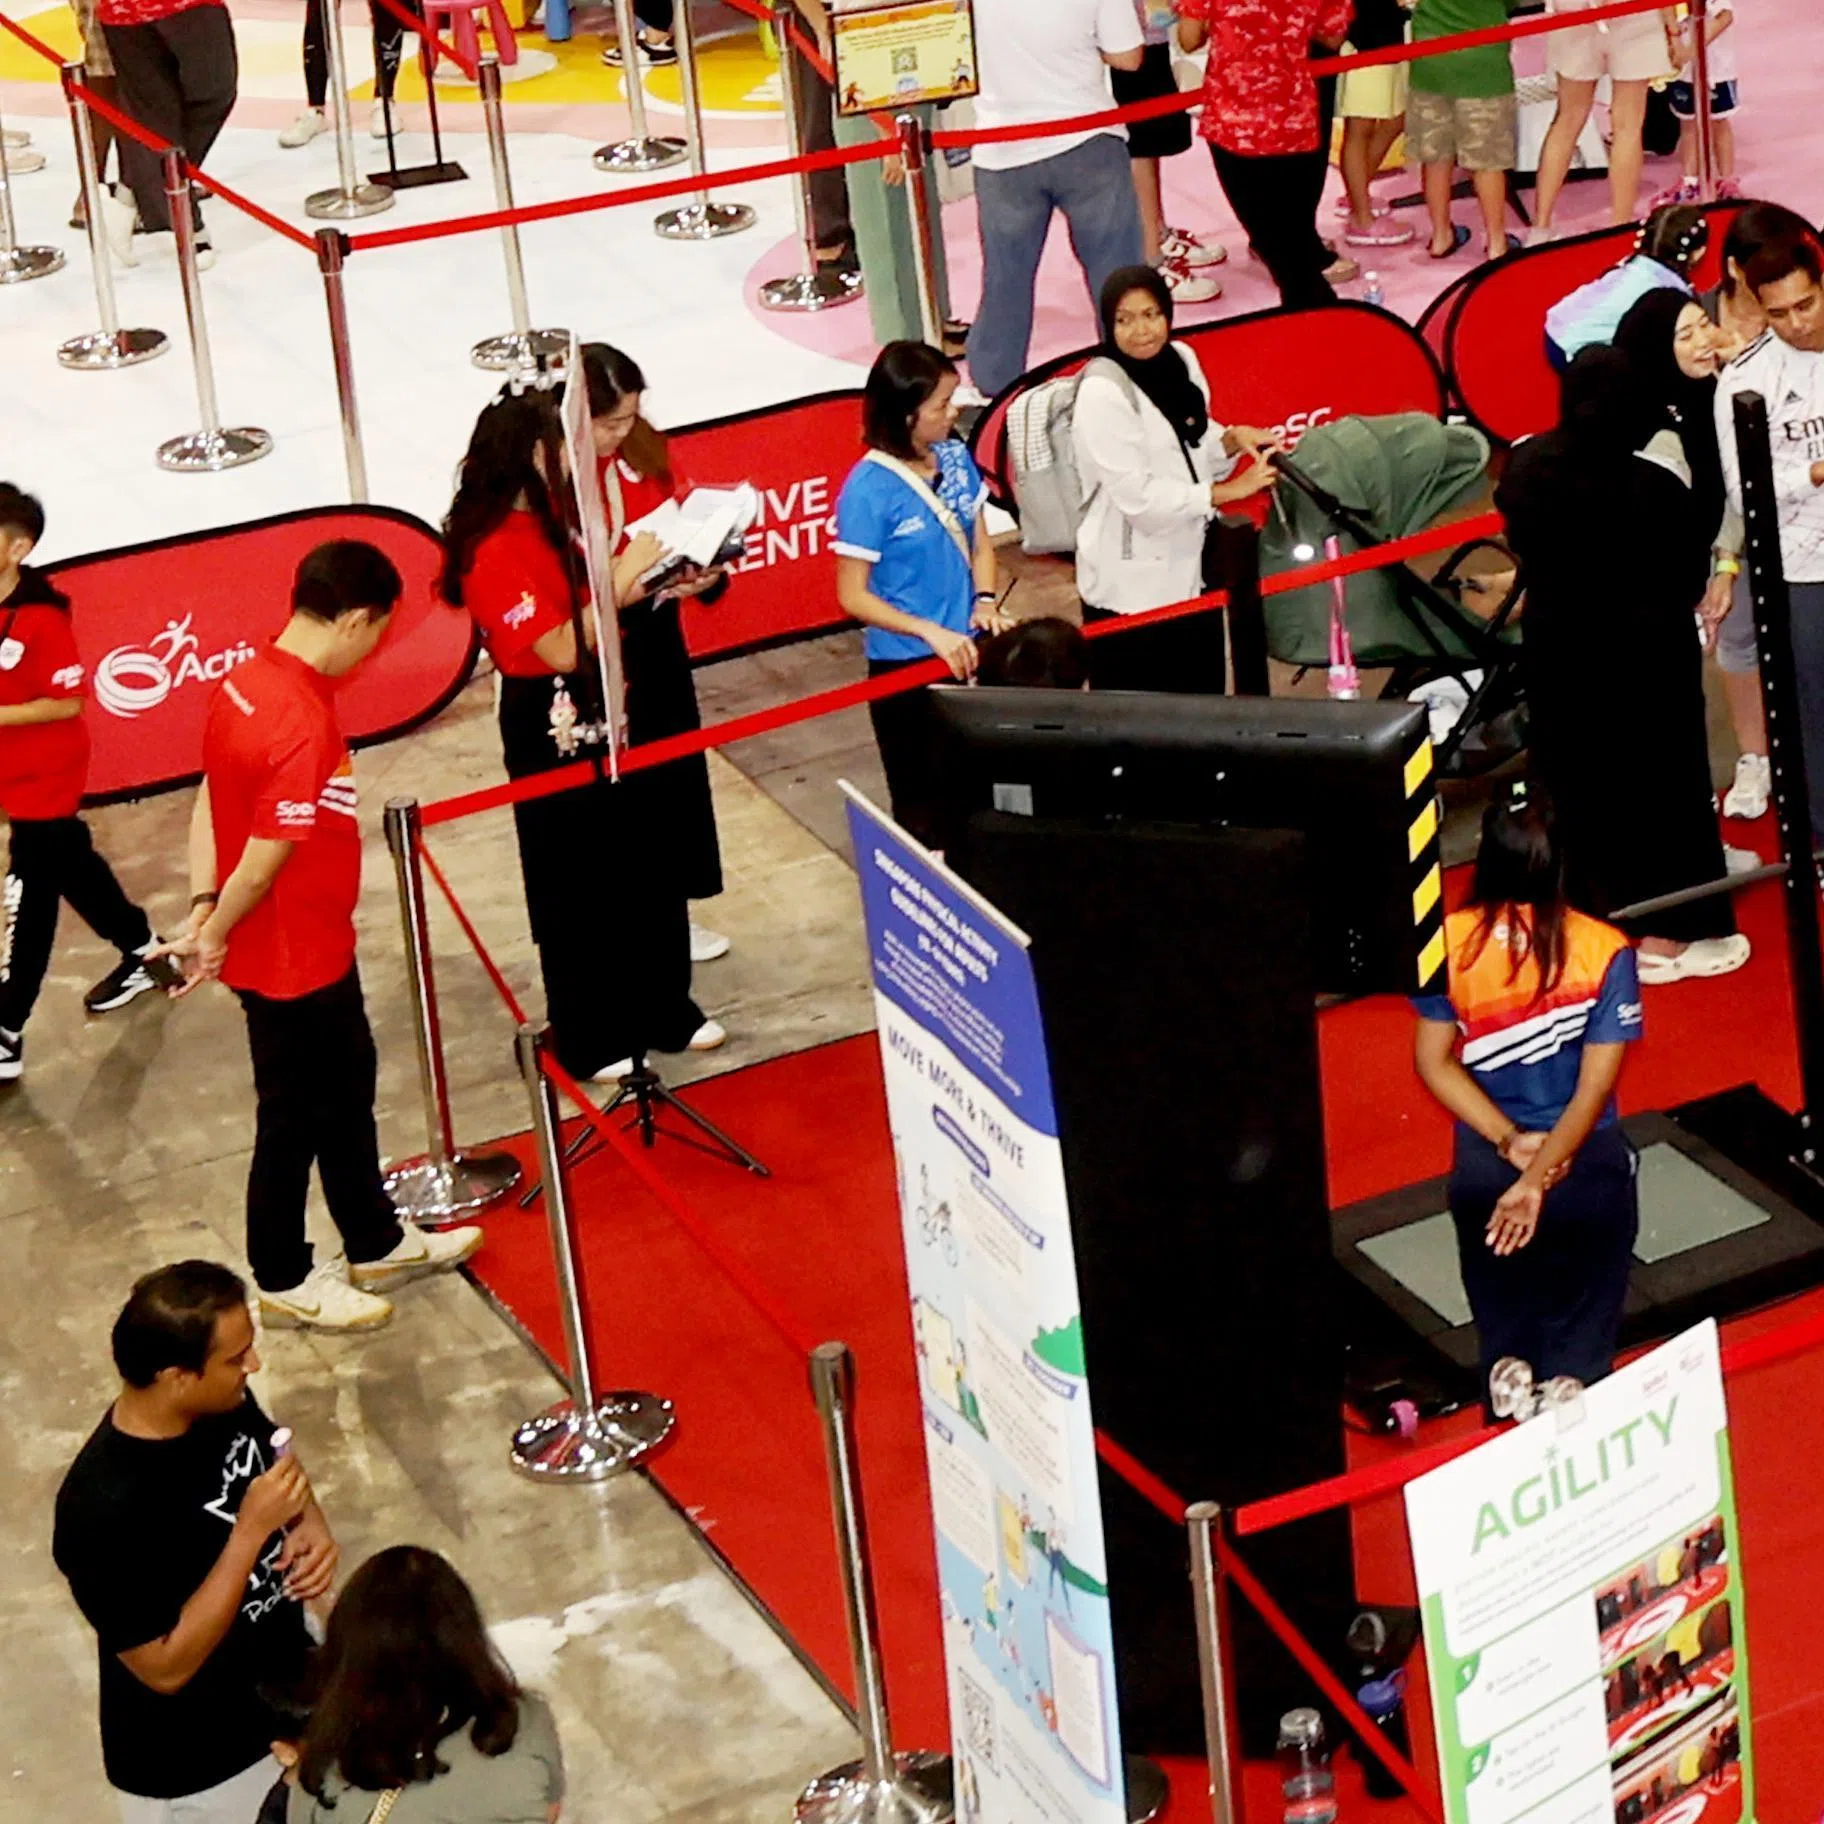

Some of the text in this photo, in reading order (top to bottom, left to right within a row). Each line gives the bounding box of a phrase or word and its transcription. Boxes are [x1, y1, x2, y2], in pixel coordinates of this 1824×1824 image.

[886, 1024, 924, 1075] MOVE
[928, 1057, 965, 1107] MORE
[980, 1106, 1025, 1170] THRIVE
[1462, 1662, 1474, 1681] 1
[1470, 1754, 1481, 1772] 2
